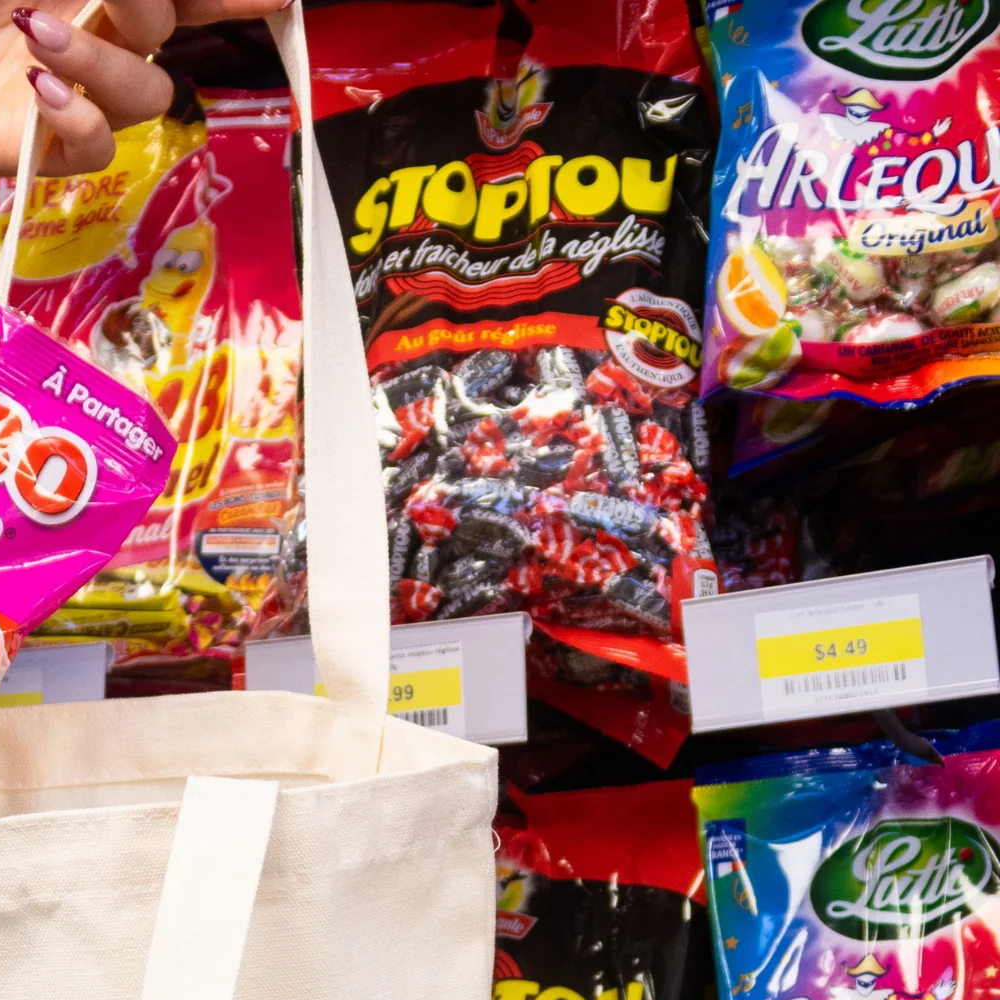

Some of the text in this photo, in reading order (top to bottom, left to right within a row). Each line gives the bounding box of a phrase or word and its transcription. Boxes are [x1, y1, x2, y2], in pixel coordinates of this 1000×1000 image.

[350, 152, 678, 256] STOPTOU
[383, 247, 410, 271] et
[410, 237, 510, 278] fraîcheur
[508, 243, 537, 271] de
[539, 229, 557, 259] la
[560, 213, 666, 277] réglisse
[861, 209, 988, 255] Original
[395, 331, 424, 351] Au
[427, 323, 476, 346] goût
[605, 305, 703, 368] STOPTOU
[921, 334, 936, 346] DE
[42, 365, 66, 396] À
[66, 383, 164, 461] Partager
[814, 638, 869, 662] $4.49
